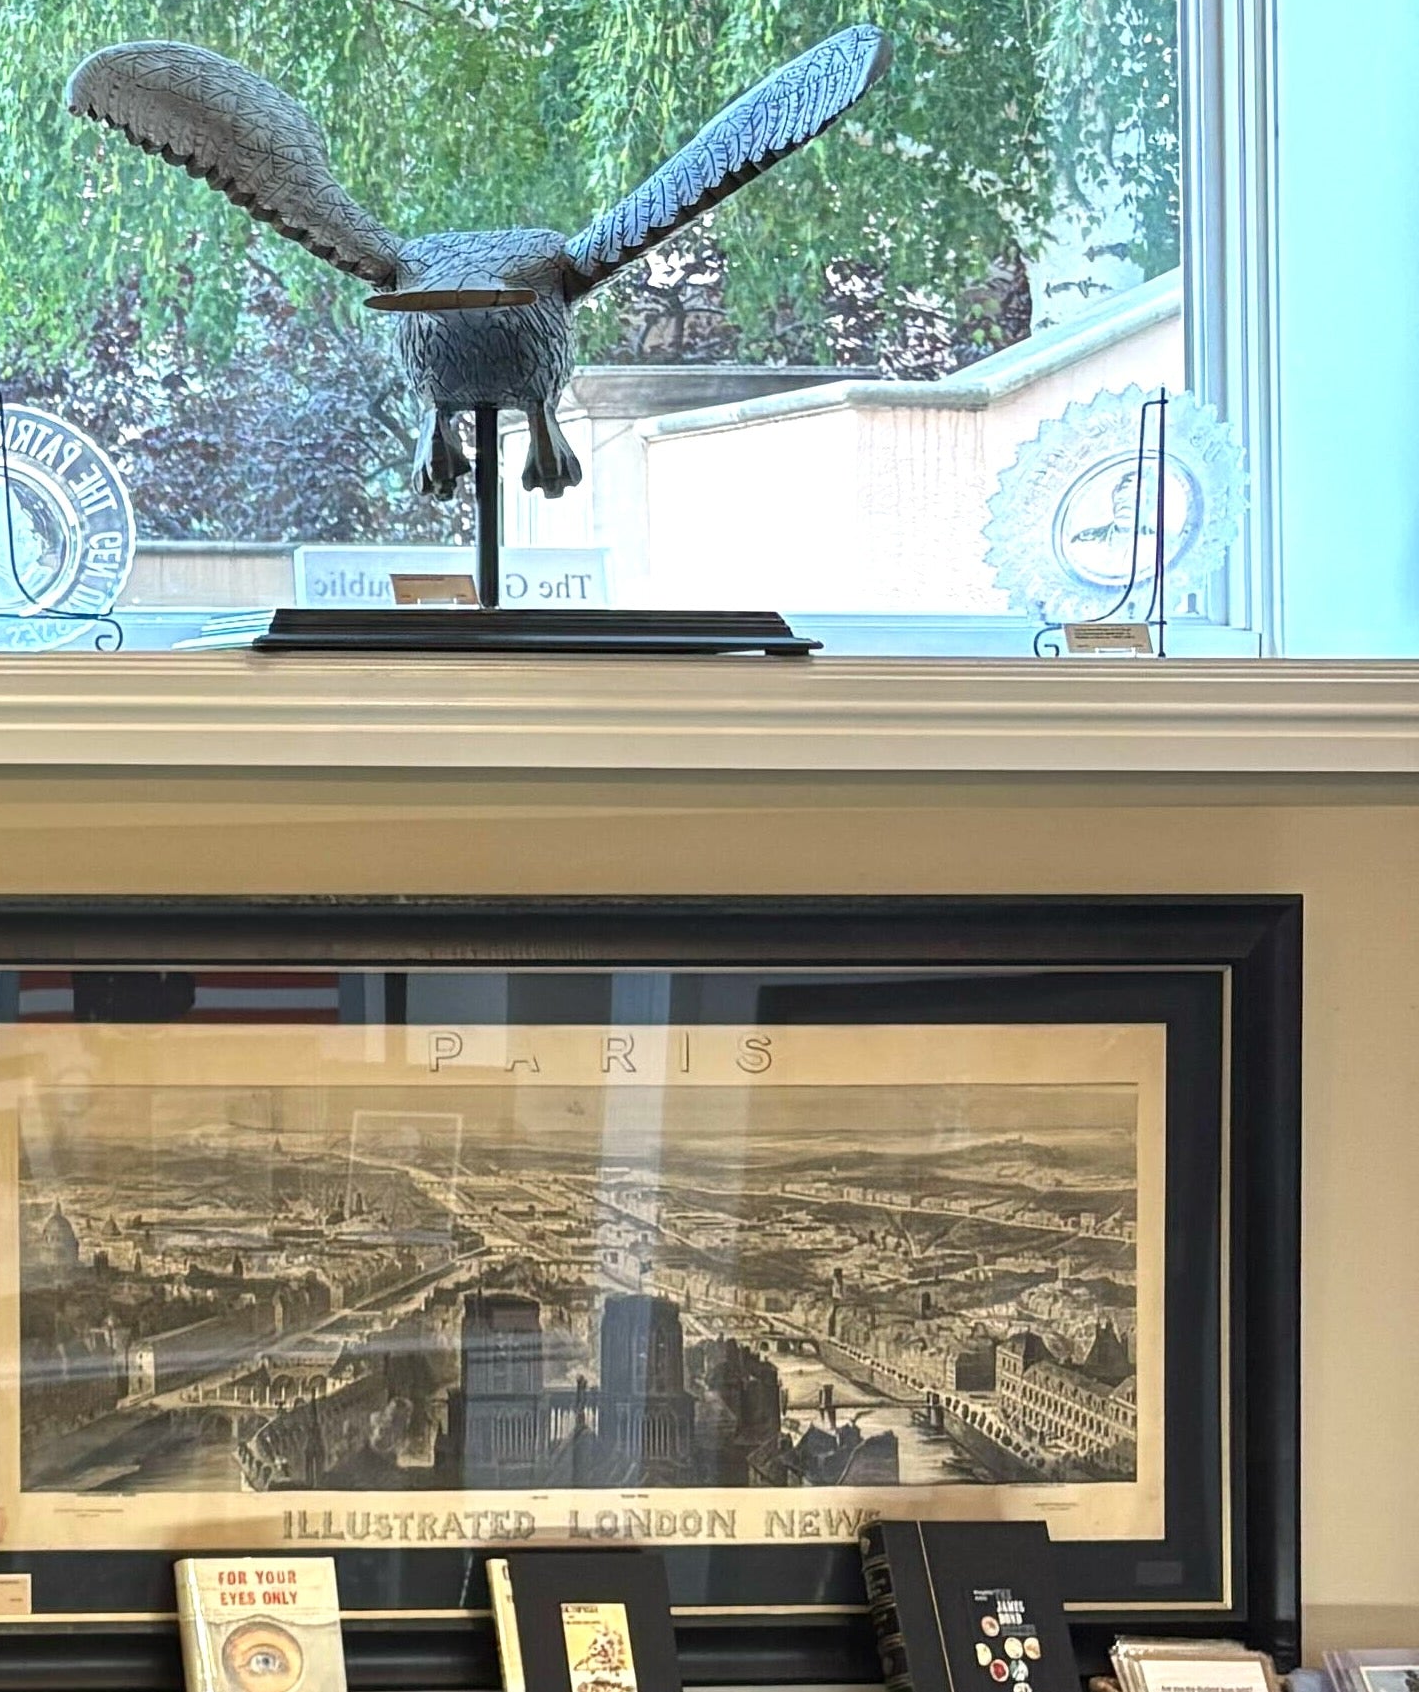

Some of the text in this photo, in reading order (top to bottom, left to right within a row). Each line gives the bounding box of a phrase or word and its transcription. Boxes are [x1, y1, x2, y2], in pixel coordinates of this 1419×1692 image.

[429, 1031, 772, 1073] PARIS
[281, 1509, 737, 1541] ILLUSTRATED LONDON
[218, 1570, 296, 1584] FOR YOUR
[220, 1591, 297, 1605] EYES ONLY
